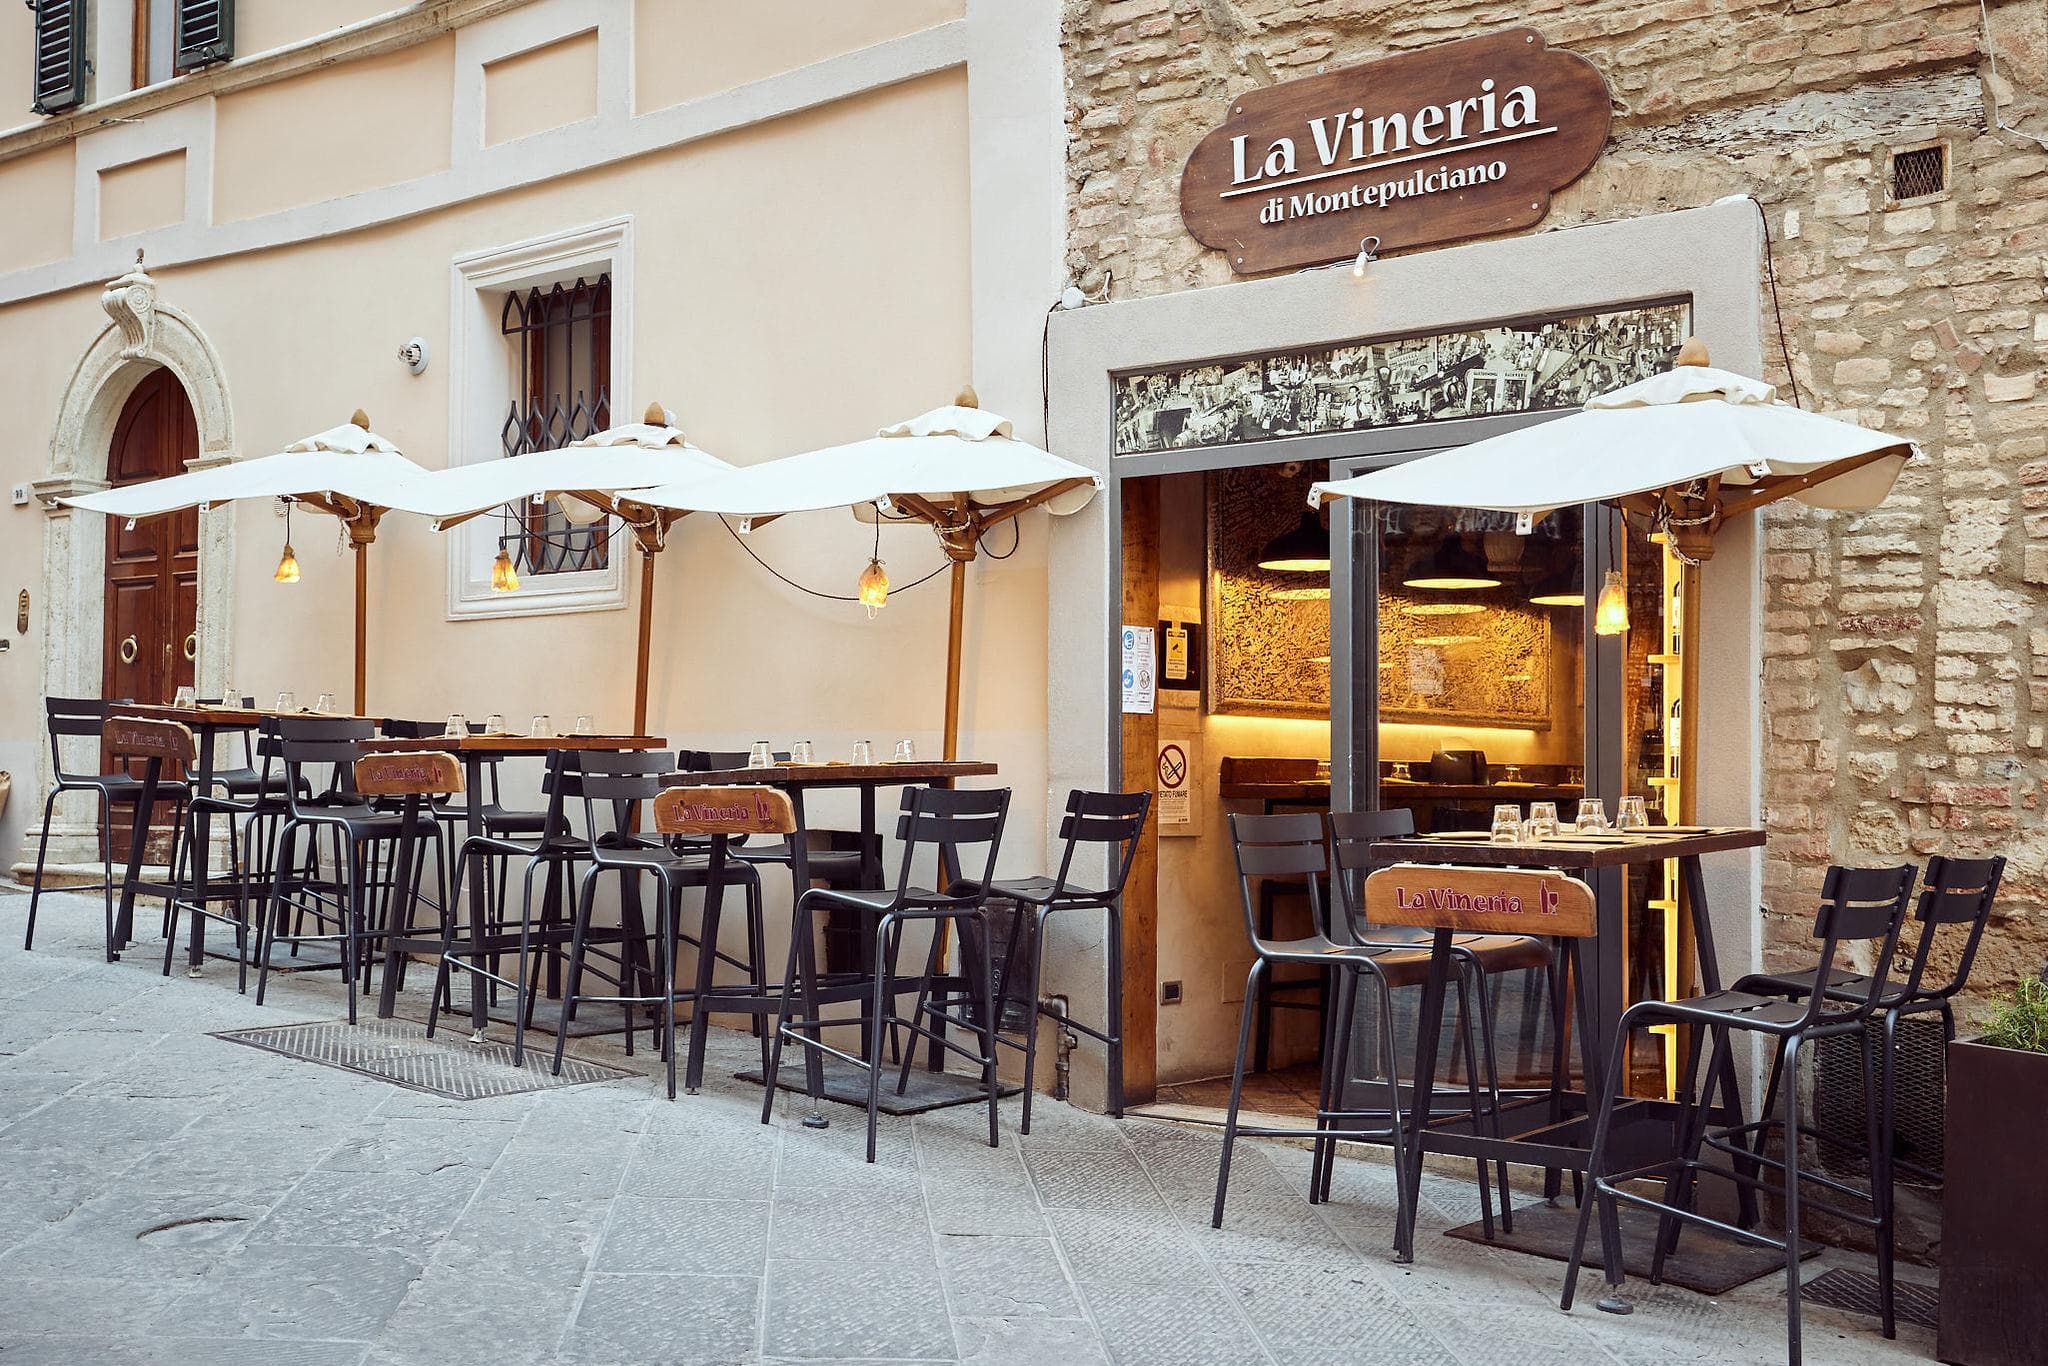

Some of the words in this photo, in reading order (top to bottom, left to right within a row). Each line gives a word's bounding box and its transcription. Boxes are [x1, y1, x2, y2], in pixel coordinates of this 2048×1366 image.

[1230, 133, 1299, 186] La
[1308, 78, 1540, 167] Vineria
[1259, 195, 1286, 226] di
[1288, 160, 1508, 219] Montepulciano
[672, 804, 692, 823] La
[691, 803, 750, 821] Vineria
[1396, 887, 1426, 910] La
[1427, 887, 1524, 914] Vineria
